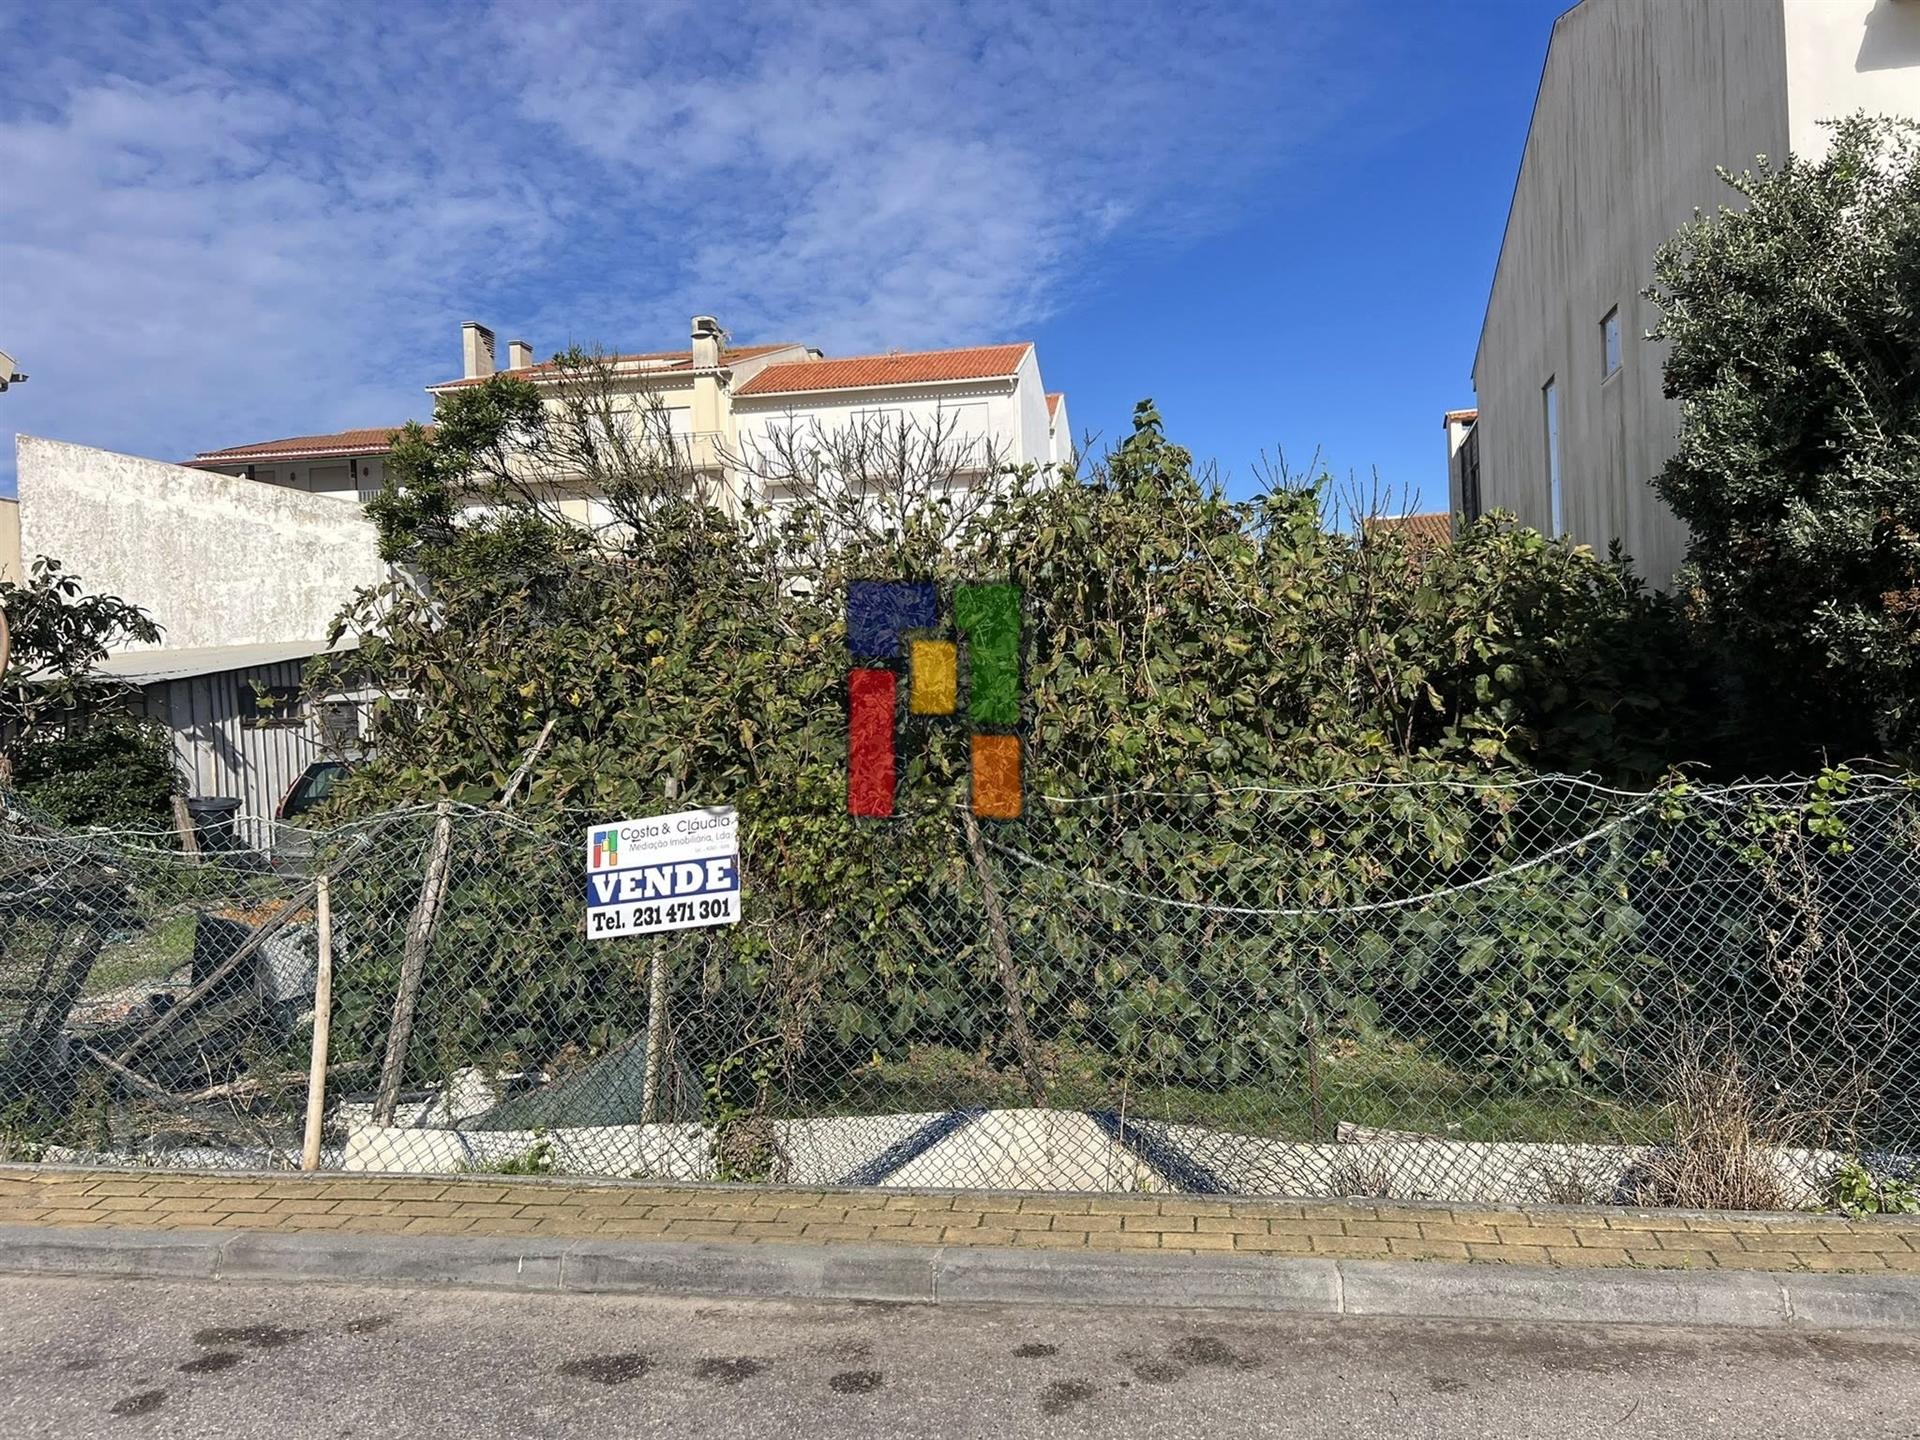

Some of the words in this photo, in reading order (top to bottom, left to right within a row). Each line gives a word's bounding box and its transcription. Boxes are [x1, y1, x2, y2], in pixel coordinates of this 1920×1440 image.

[621, 825, 659, 842] Costa
[662, 822, 671, 835] &
[677, 817, 730, 834] Cláudia
[629, 840, 668, 852] Mediação
[592, 858, 731, 903] VENDE
[592, 910, 625, 932] Tel.
[633, 905, 662, 927] 231
[666, 901, 695, 923] 471
[700, 897, 731, 920] 301
